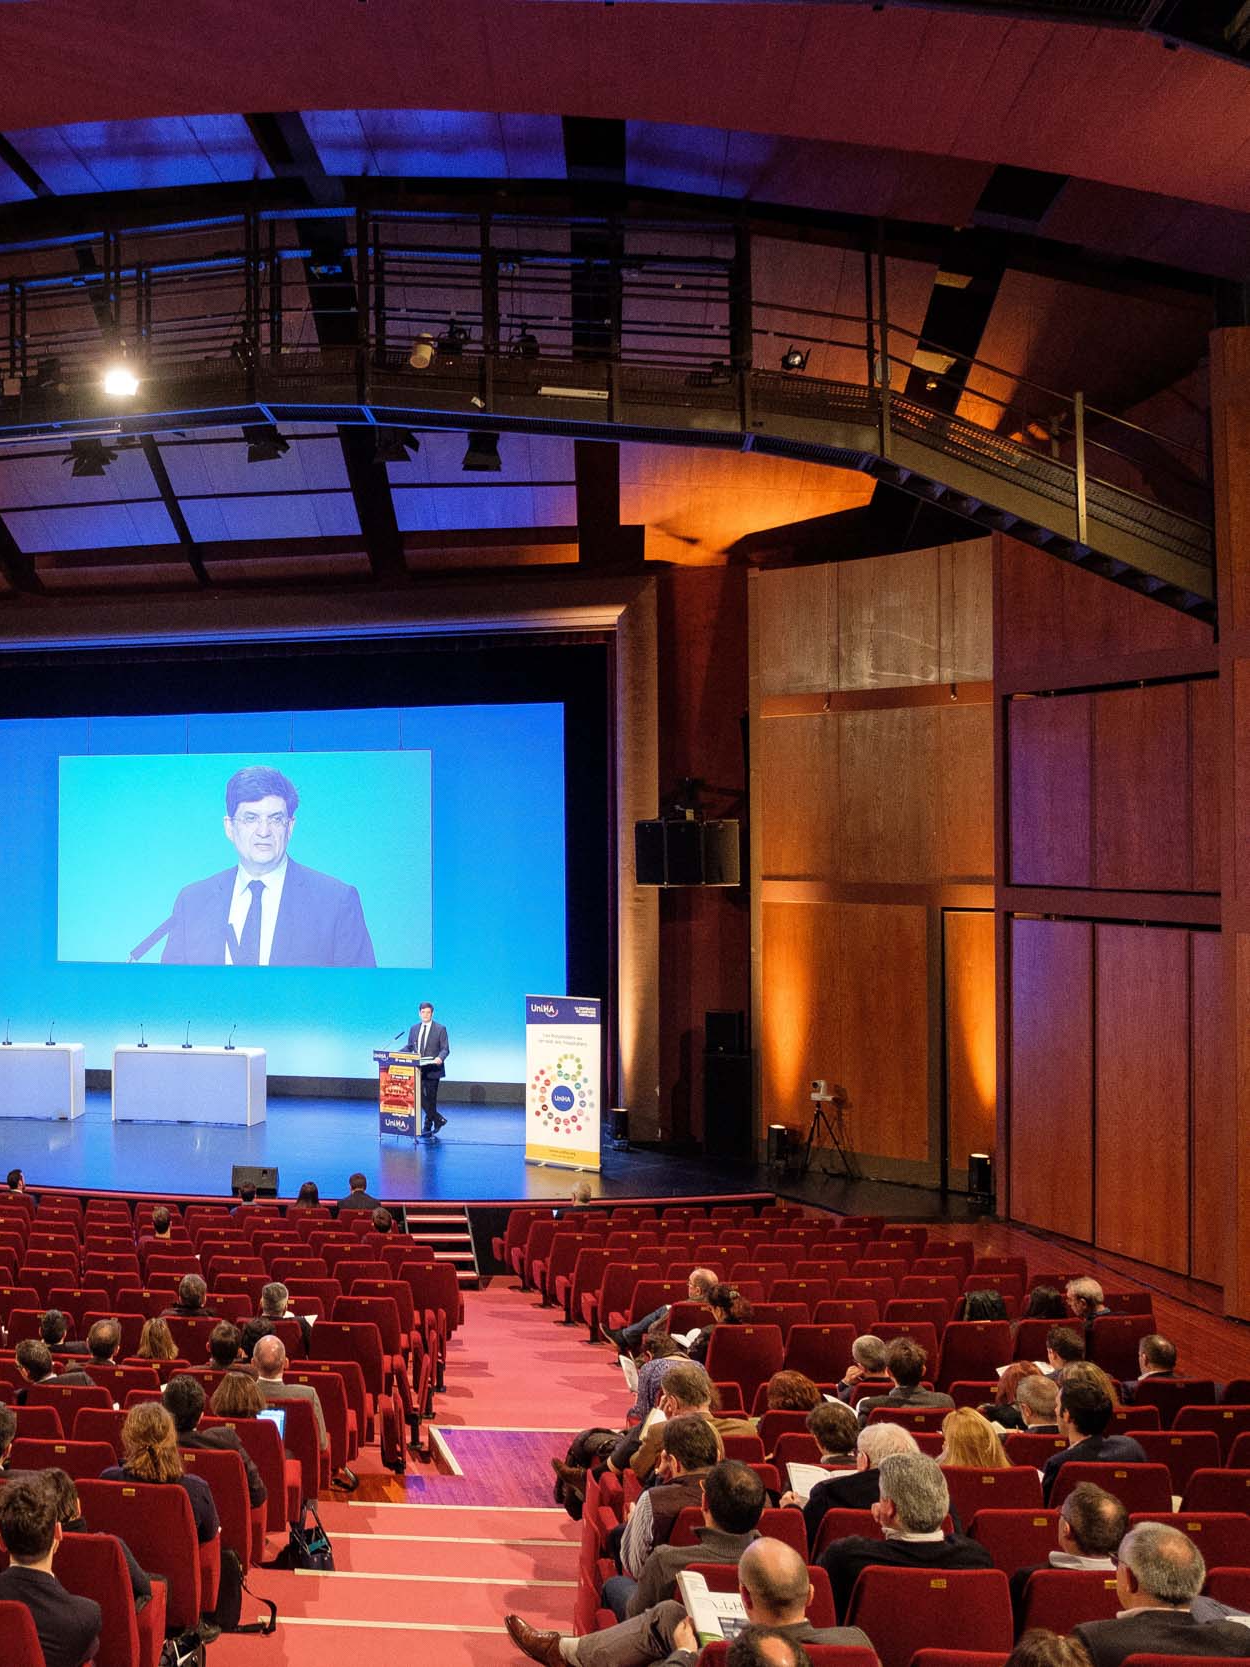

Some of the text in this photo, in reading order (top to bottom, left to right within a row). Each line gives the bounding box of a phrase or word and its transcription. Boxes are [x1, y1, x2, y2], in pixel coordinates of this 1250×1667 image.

[530, 1003, 555, 1014] UniHA
[554, 1095, 571, 1104] UniHA
[385, 1119, 406, 1128] UniHA
